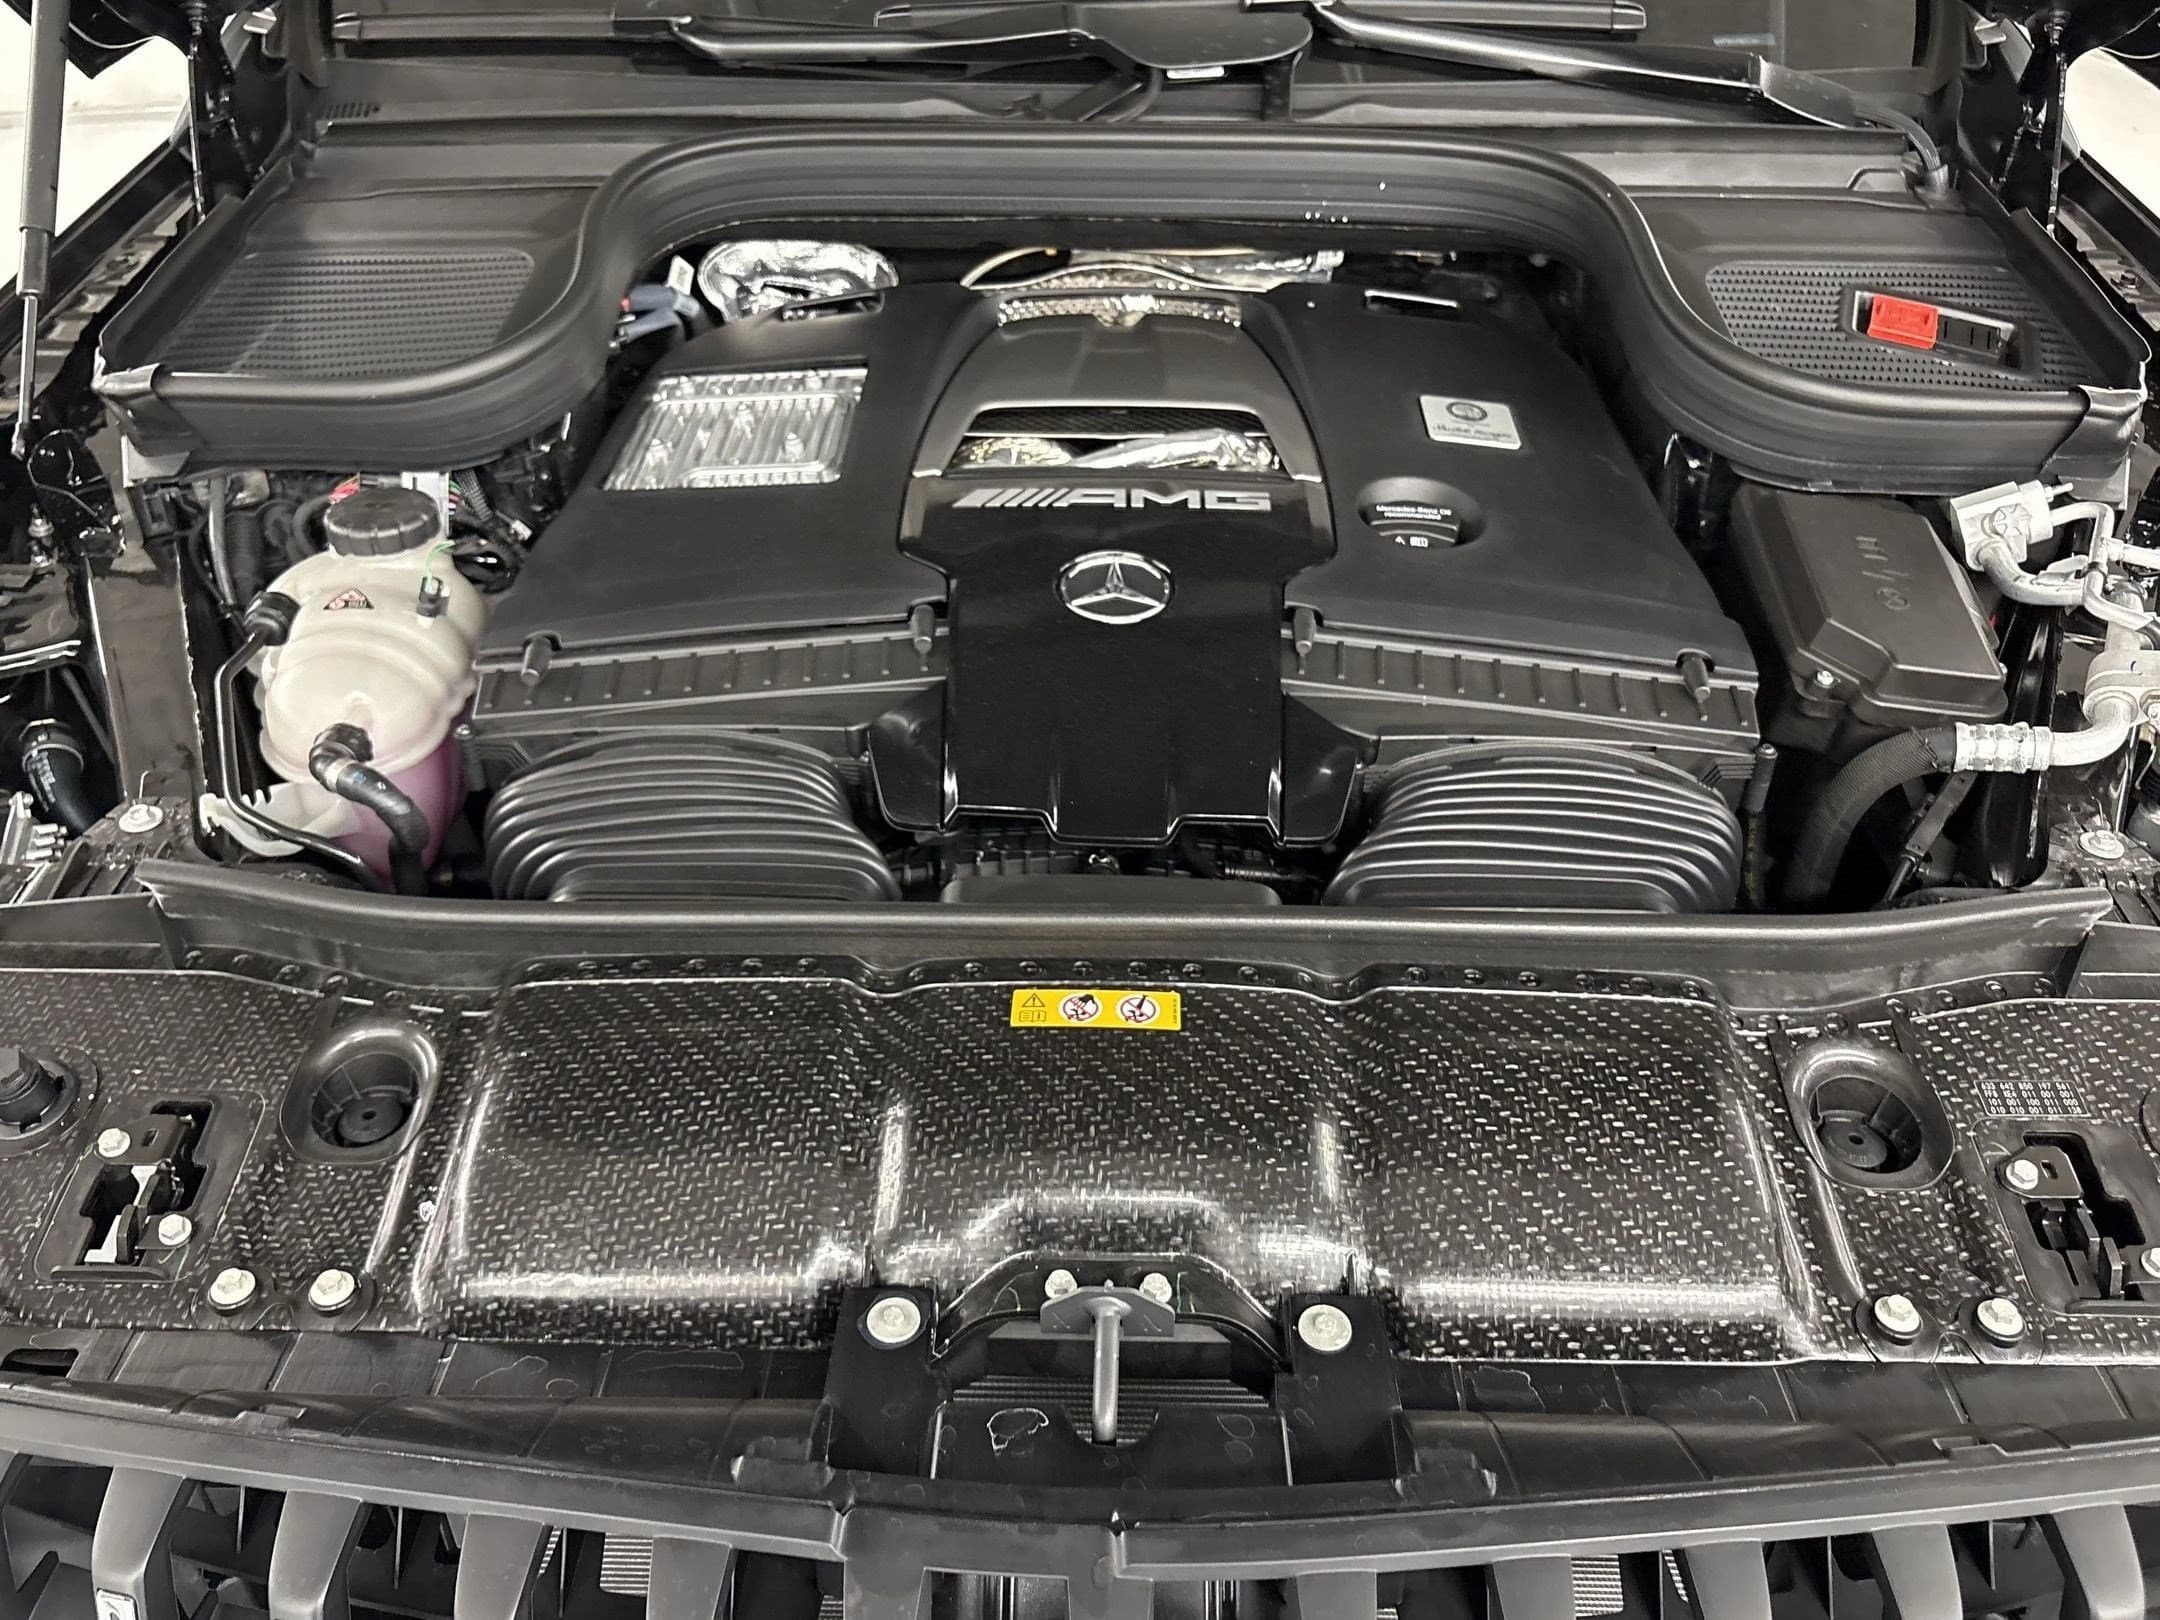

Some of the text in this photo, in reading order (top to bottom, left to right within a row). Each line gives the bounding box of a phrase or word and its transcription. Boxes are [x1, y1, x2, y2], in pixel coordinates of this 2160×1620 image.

[1053, 488, 1271, 511] AMG
[2021, 1090, 2036, 1098] 011
[2041, 1090, 2055, 1098] 001
[2059, 1090, 2074, 1098] 001
[1988, 1098, 2078, 1106] 101 001 100 011 000
[1990, 1106, 2006, 1114] 010
[2009, 1106, 2025, 1114] 010
[2028, 1106, 2043, 1114] 001
[2047, 1106, 2063, 1114] 011
